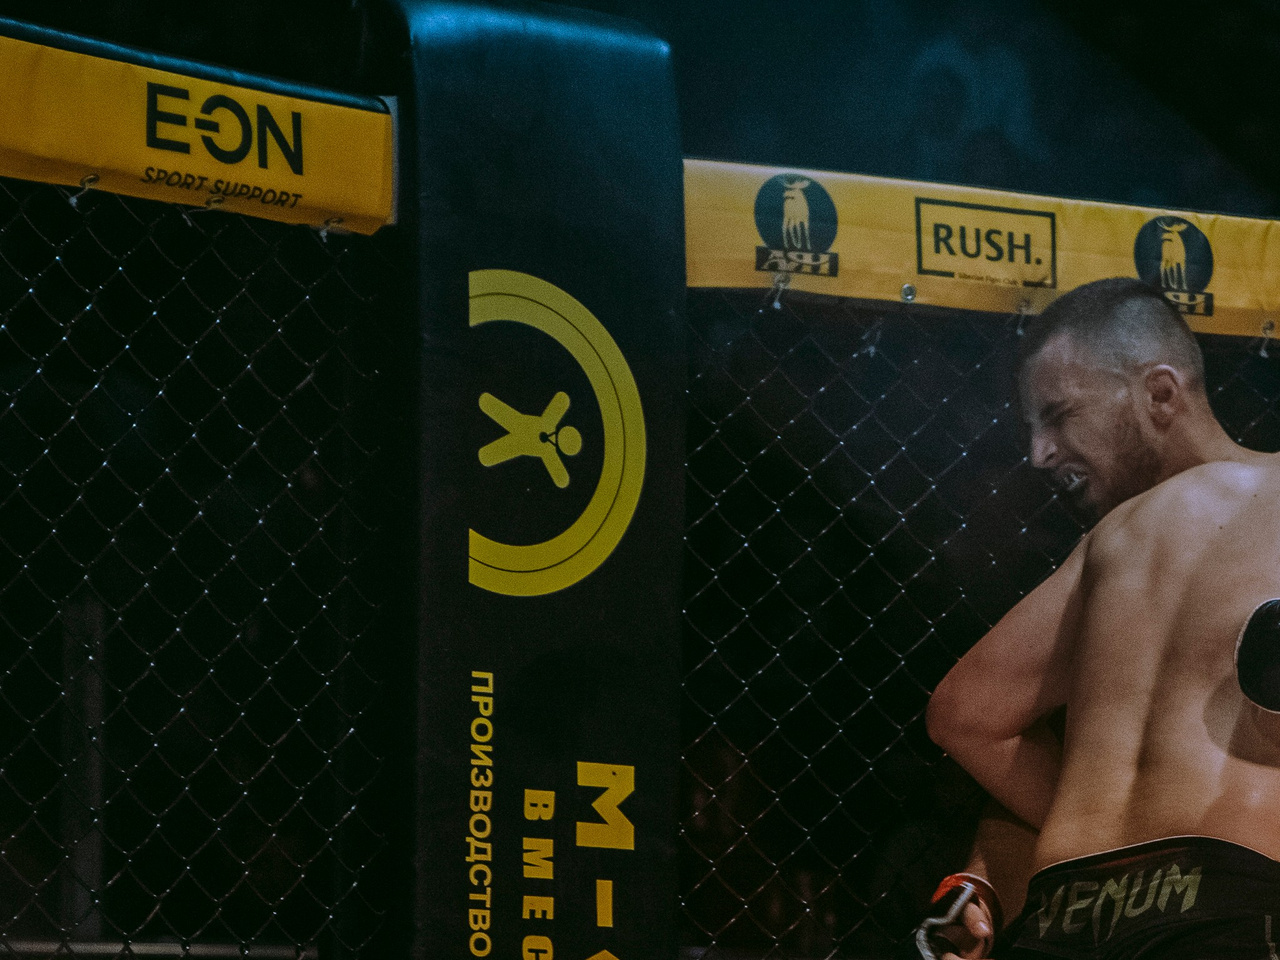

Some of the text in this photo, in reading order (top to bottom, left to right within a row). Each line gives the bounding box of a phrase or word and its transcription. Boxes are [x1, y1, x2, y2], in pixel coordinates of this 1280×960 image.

[140, 166, 303, 208] SPORT SUPPORT
[932, 222, 1043, 265] RUSH.
[465, 670, 494, 958] ПРОИЗВОДСТВО
[1037, 863, 1203, 948] VENUM
